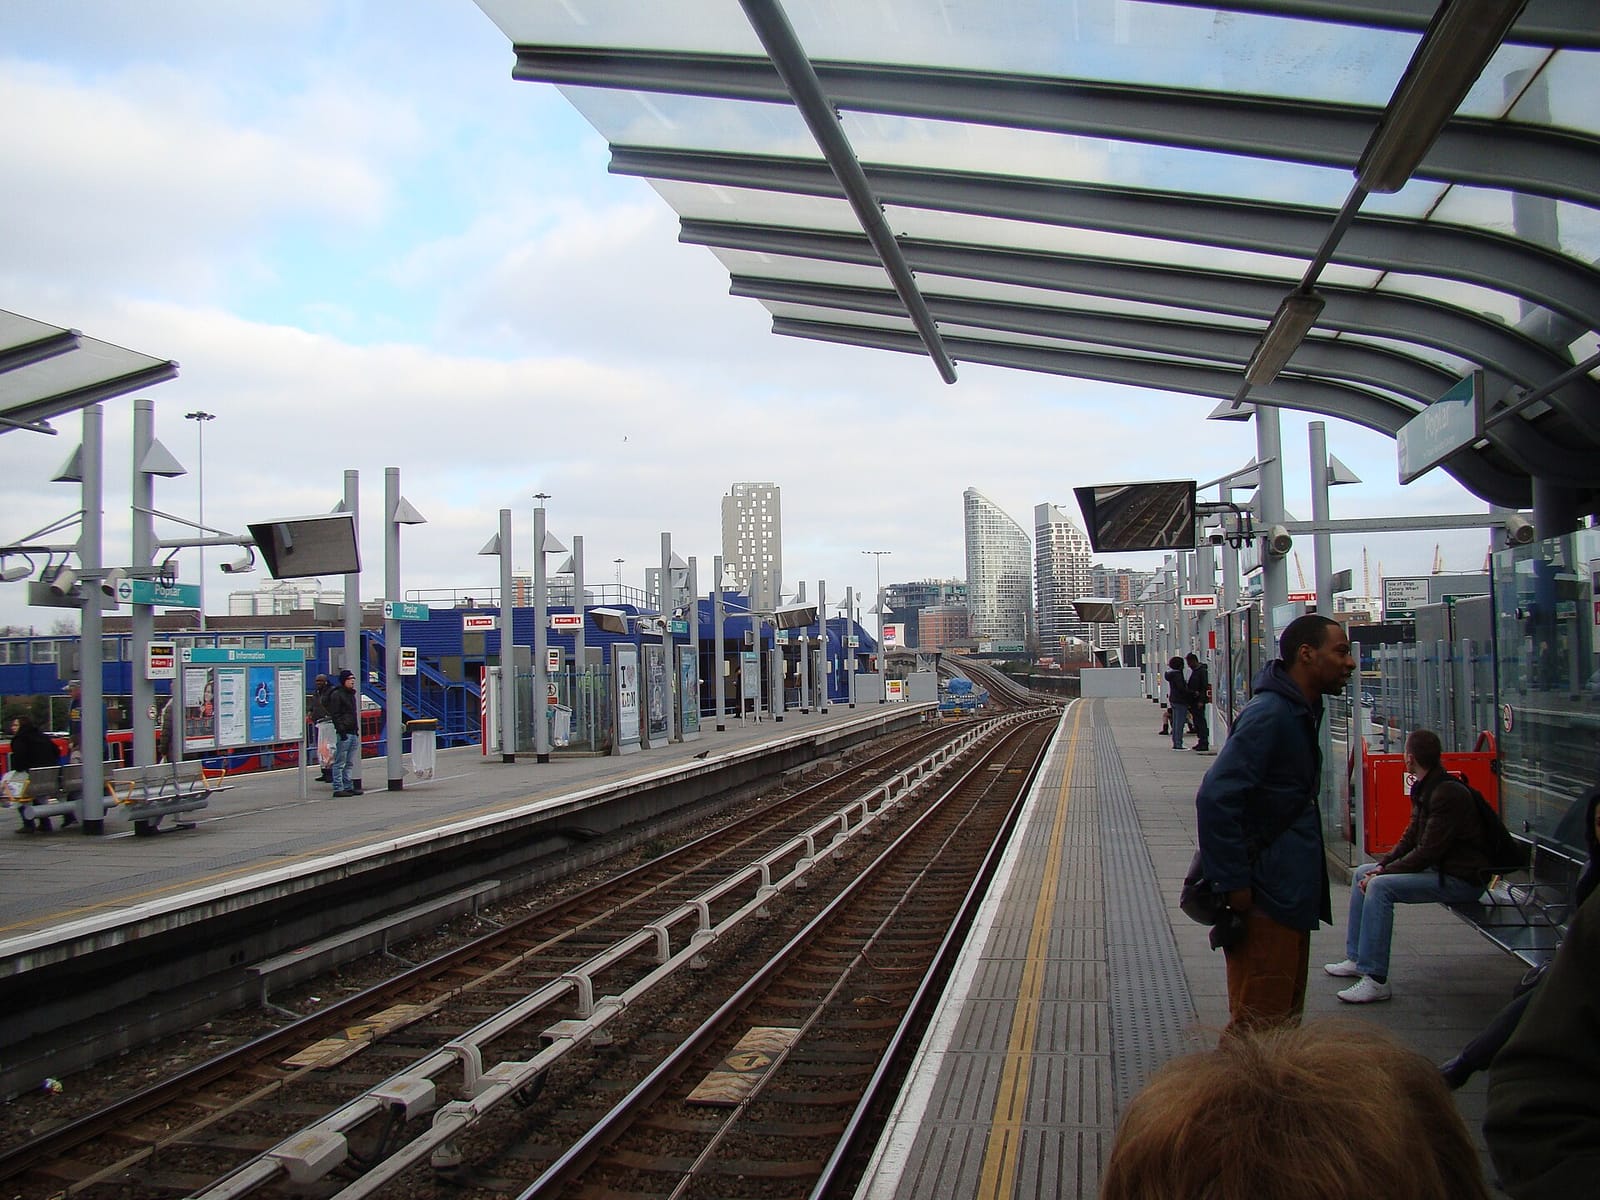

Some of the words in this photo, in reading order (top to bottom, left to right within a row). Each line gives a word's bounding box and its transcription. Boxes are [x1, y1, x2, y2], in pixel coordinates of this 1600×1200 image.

[1424, 405, 1449, 440] Poplar
[154, 583, 180, 598] Poplar
[403, 603, 418, 615] Poplar
[236, 650, 265, 660] Information
[621, 691, 636, 708] LDN
